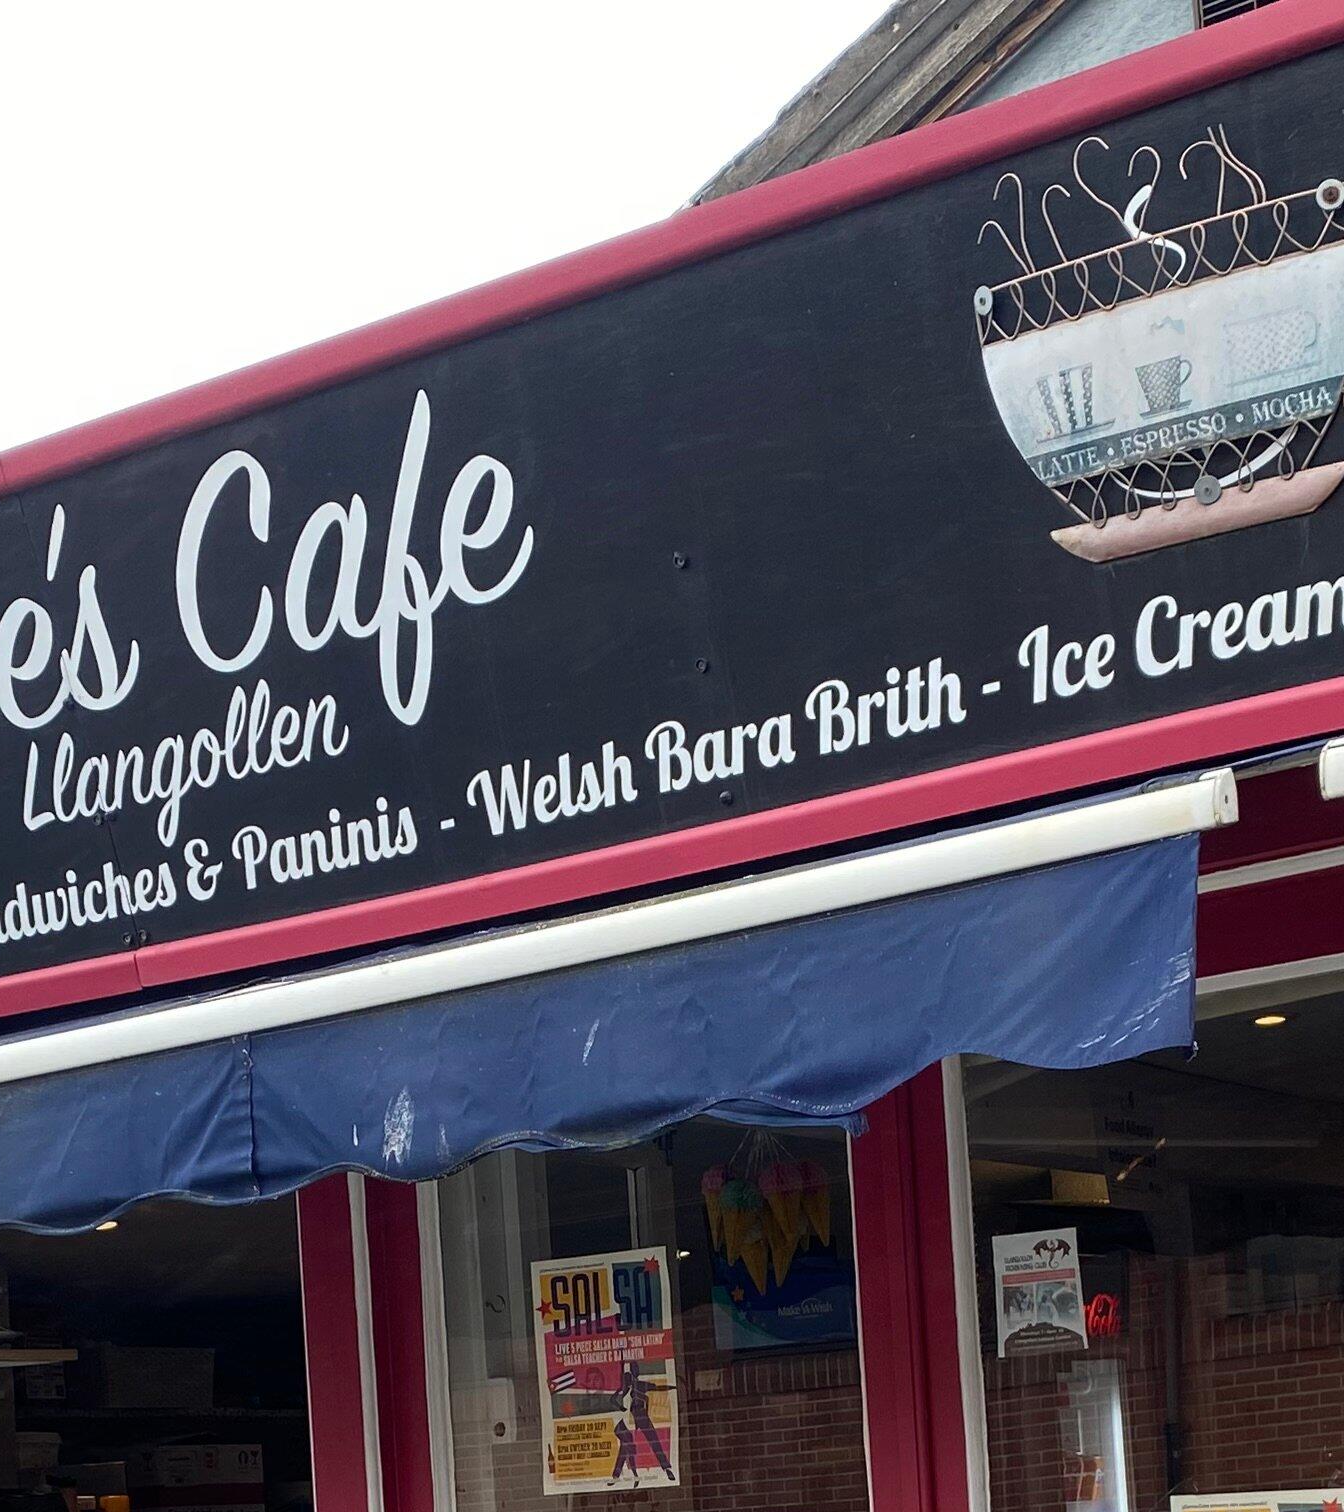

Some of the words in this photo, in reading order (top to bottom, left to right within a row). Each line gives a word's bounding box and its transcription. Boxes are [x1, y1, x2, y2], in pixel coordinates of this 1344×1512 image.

[1120, 415, 1226, 456] ESPRESSO
[1253, 387, 1333, 425] MOCHA
[177, 389, 533, 725] Cafe
[23, 679, 349, 845] Llangollen
[184, 839, 222, 900] &
[233, 798, 418, 891] Paninis
[467, 741, 637, 835] Welsh
[645, 714, 796, 792] Bara
[806, 658, 966, 754] Brith
[1019, 625, 1115, 703] Ice
[550, 1267, 654, 1338] SALSA
